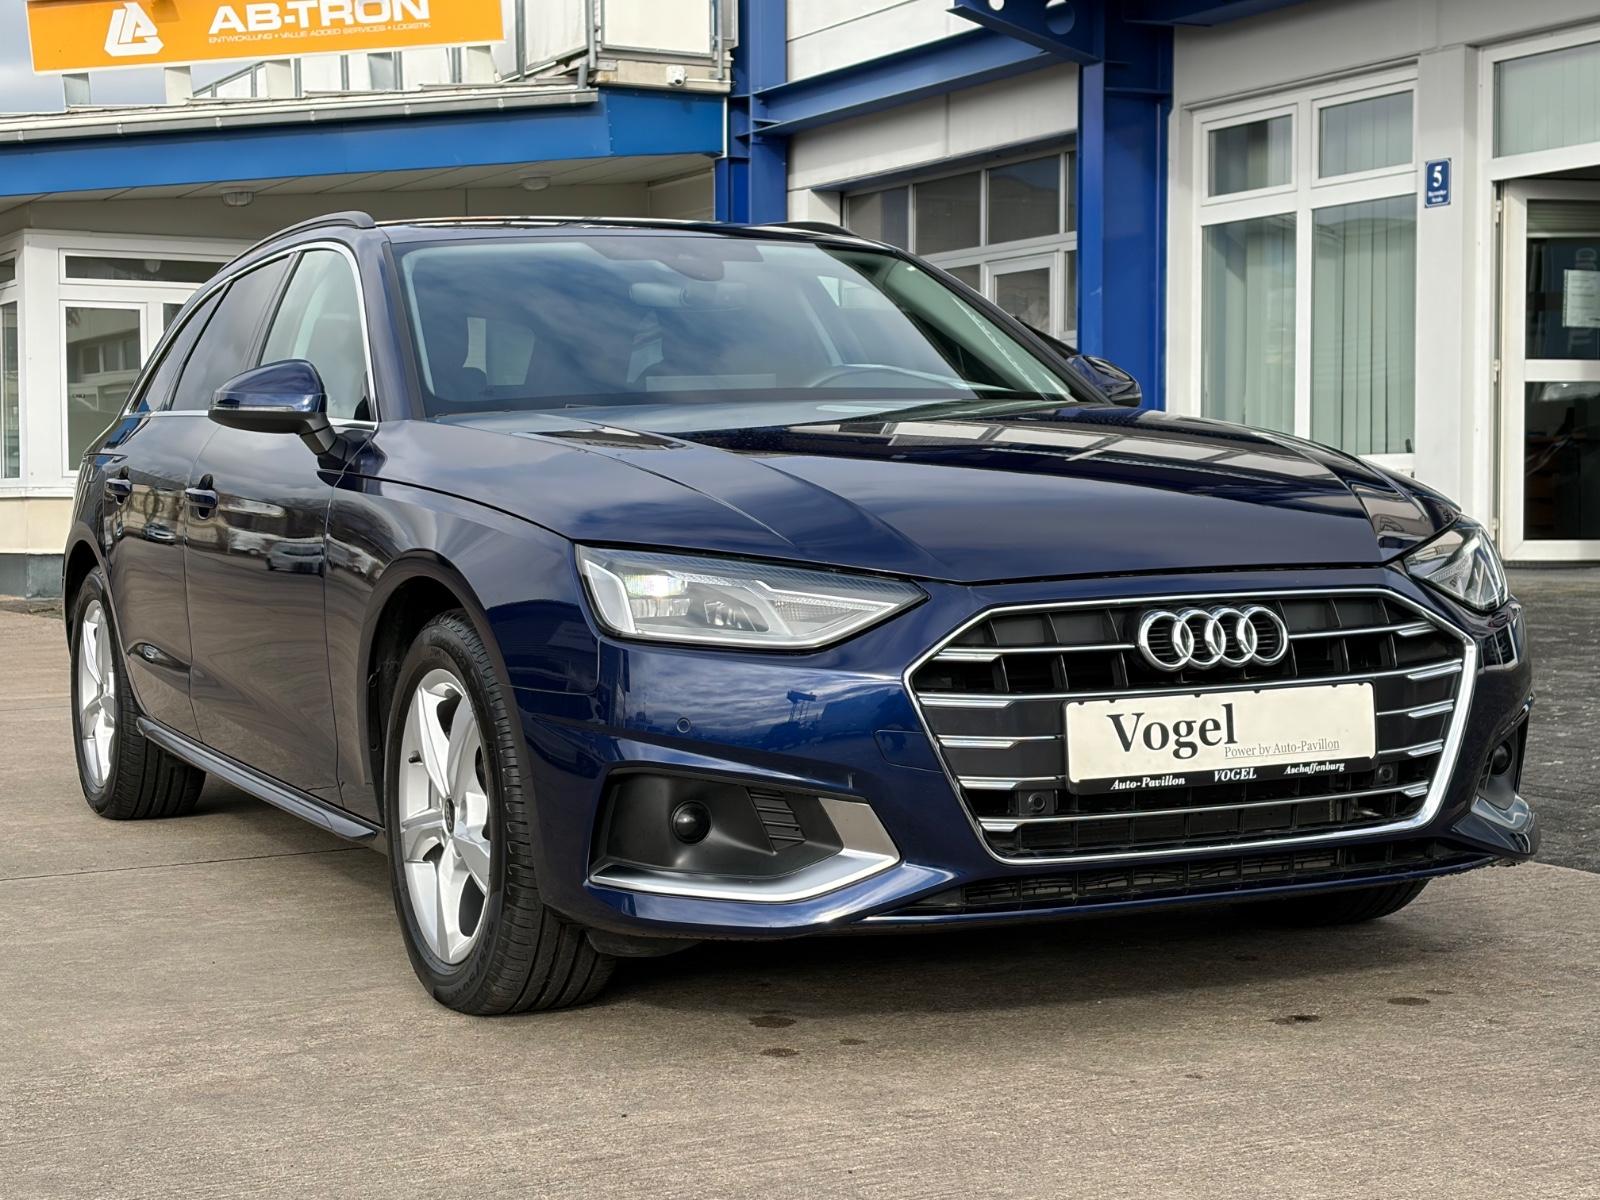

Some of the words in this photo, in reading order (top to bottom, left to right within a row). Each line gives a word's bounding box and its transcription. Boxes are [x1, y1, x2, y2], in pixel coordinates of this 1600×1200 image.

[208, 0, 430, 34] AB-TRON
[208, 33, 273, 44] ENTWICKLUNG
[280, 30, 308, 39] VALUE
[310, 27, 341, 37] ADDED
[1432, 165, 1442, 187] 5
[1107, 703, 1238, 759] Vogel
[1224, 745, 1257, 757] Power
[1259, 743, 1272, 757] by
[1273, 739, 1340, 754] Auto-Pavillon
[1110, 776, 1186, 790] Auto-Pavillon
[1214, 768, 1257, 782] VOGEL
[1283, 762, 1345, 775] Aschaffenburg
